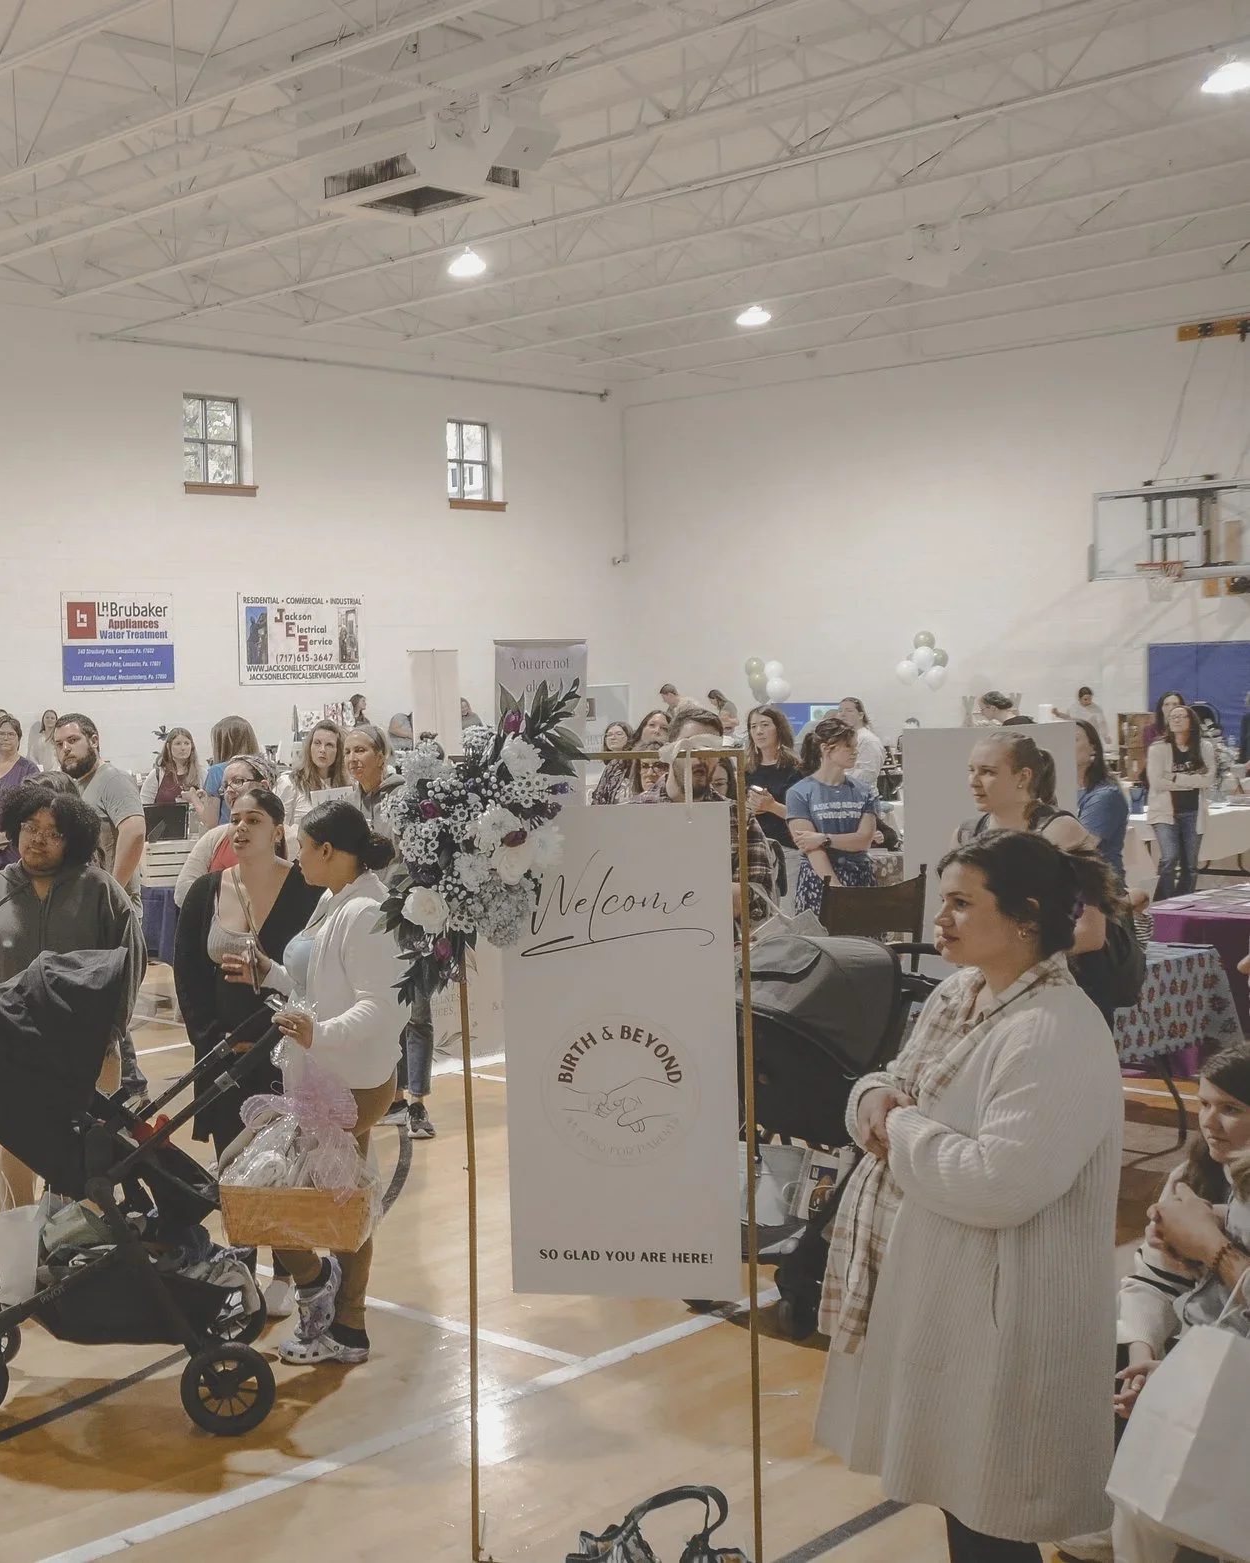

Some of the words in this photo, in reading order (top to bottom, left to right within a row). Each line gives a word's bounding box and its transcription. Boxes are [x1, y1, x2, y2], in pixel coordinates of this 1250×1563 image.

[286, 597, 323, 605] COMMERCIAL
[274, 608, 312, 623] Jackson
[108, 619, 159, 630] Appliances
[285, 622, 327, 637] Electrical
[99, 630, 124, 639] Water
[127, 630, 168, 639] Treatment
[298, 635, 333, 652] Service
[275, 653, 333, 664] (717)615-3647
[511, 657, 532, 670] You
[534, 660, 552, 669] are
[553, 657, 570, 669] not
[246, 664, 361, 673] WWW.JACKSONELECTRICALSERVICE.COM
[249, 672, 359, 681] JACKSONELECTRICALSERV@GMAIL.COM
[813, 802, 829, 811] ASK
[530, 850, 701, 943] Welcome
[558, 1032, 597, 1083] BIRTH
[602, 1026, 614, 1040] &
[620, 1025, 682, 1083] BEYOND
[539, 1249, 558, 1260] SO
[563, 1250, 600, 1260] GLAD
[605, 1250, 635, 1261] YOU
[640, 1252, 666, 1262] ARE
[672, 1252, 713, 1264] HERE!
